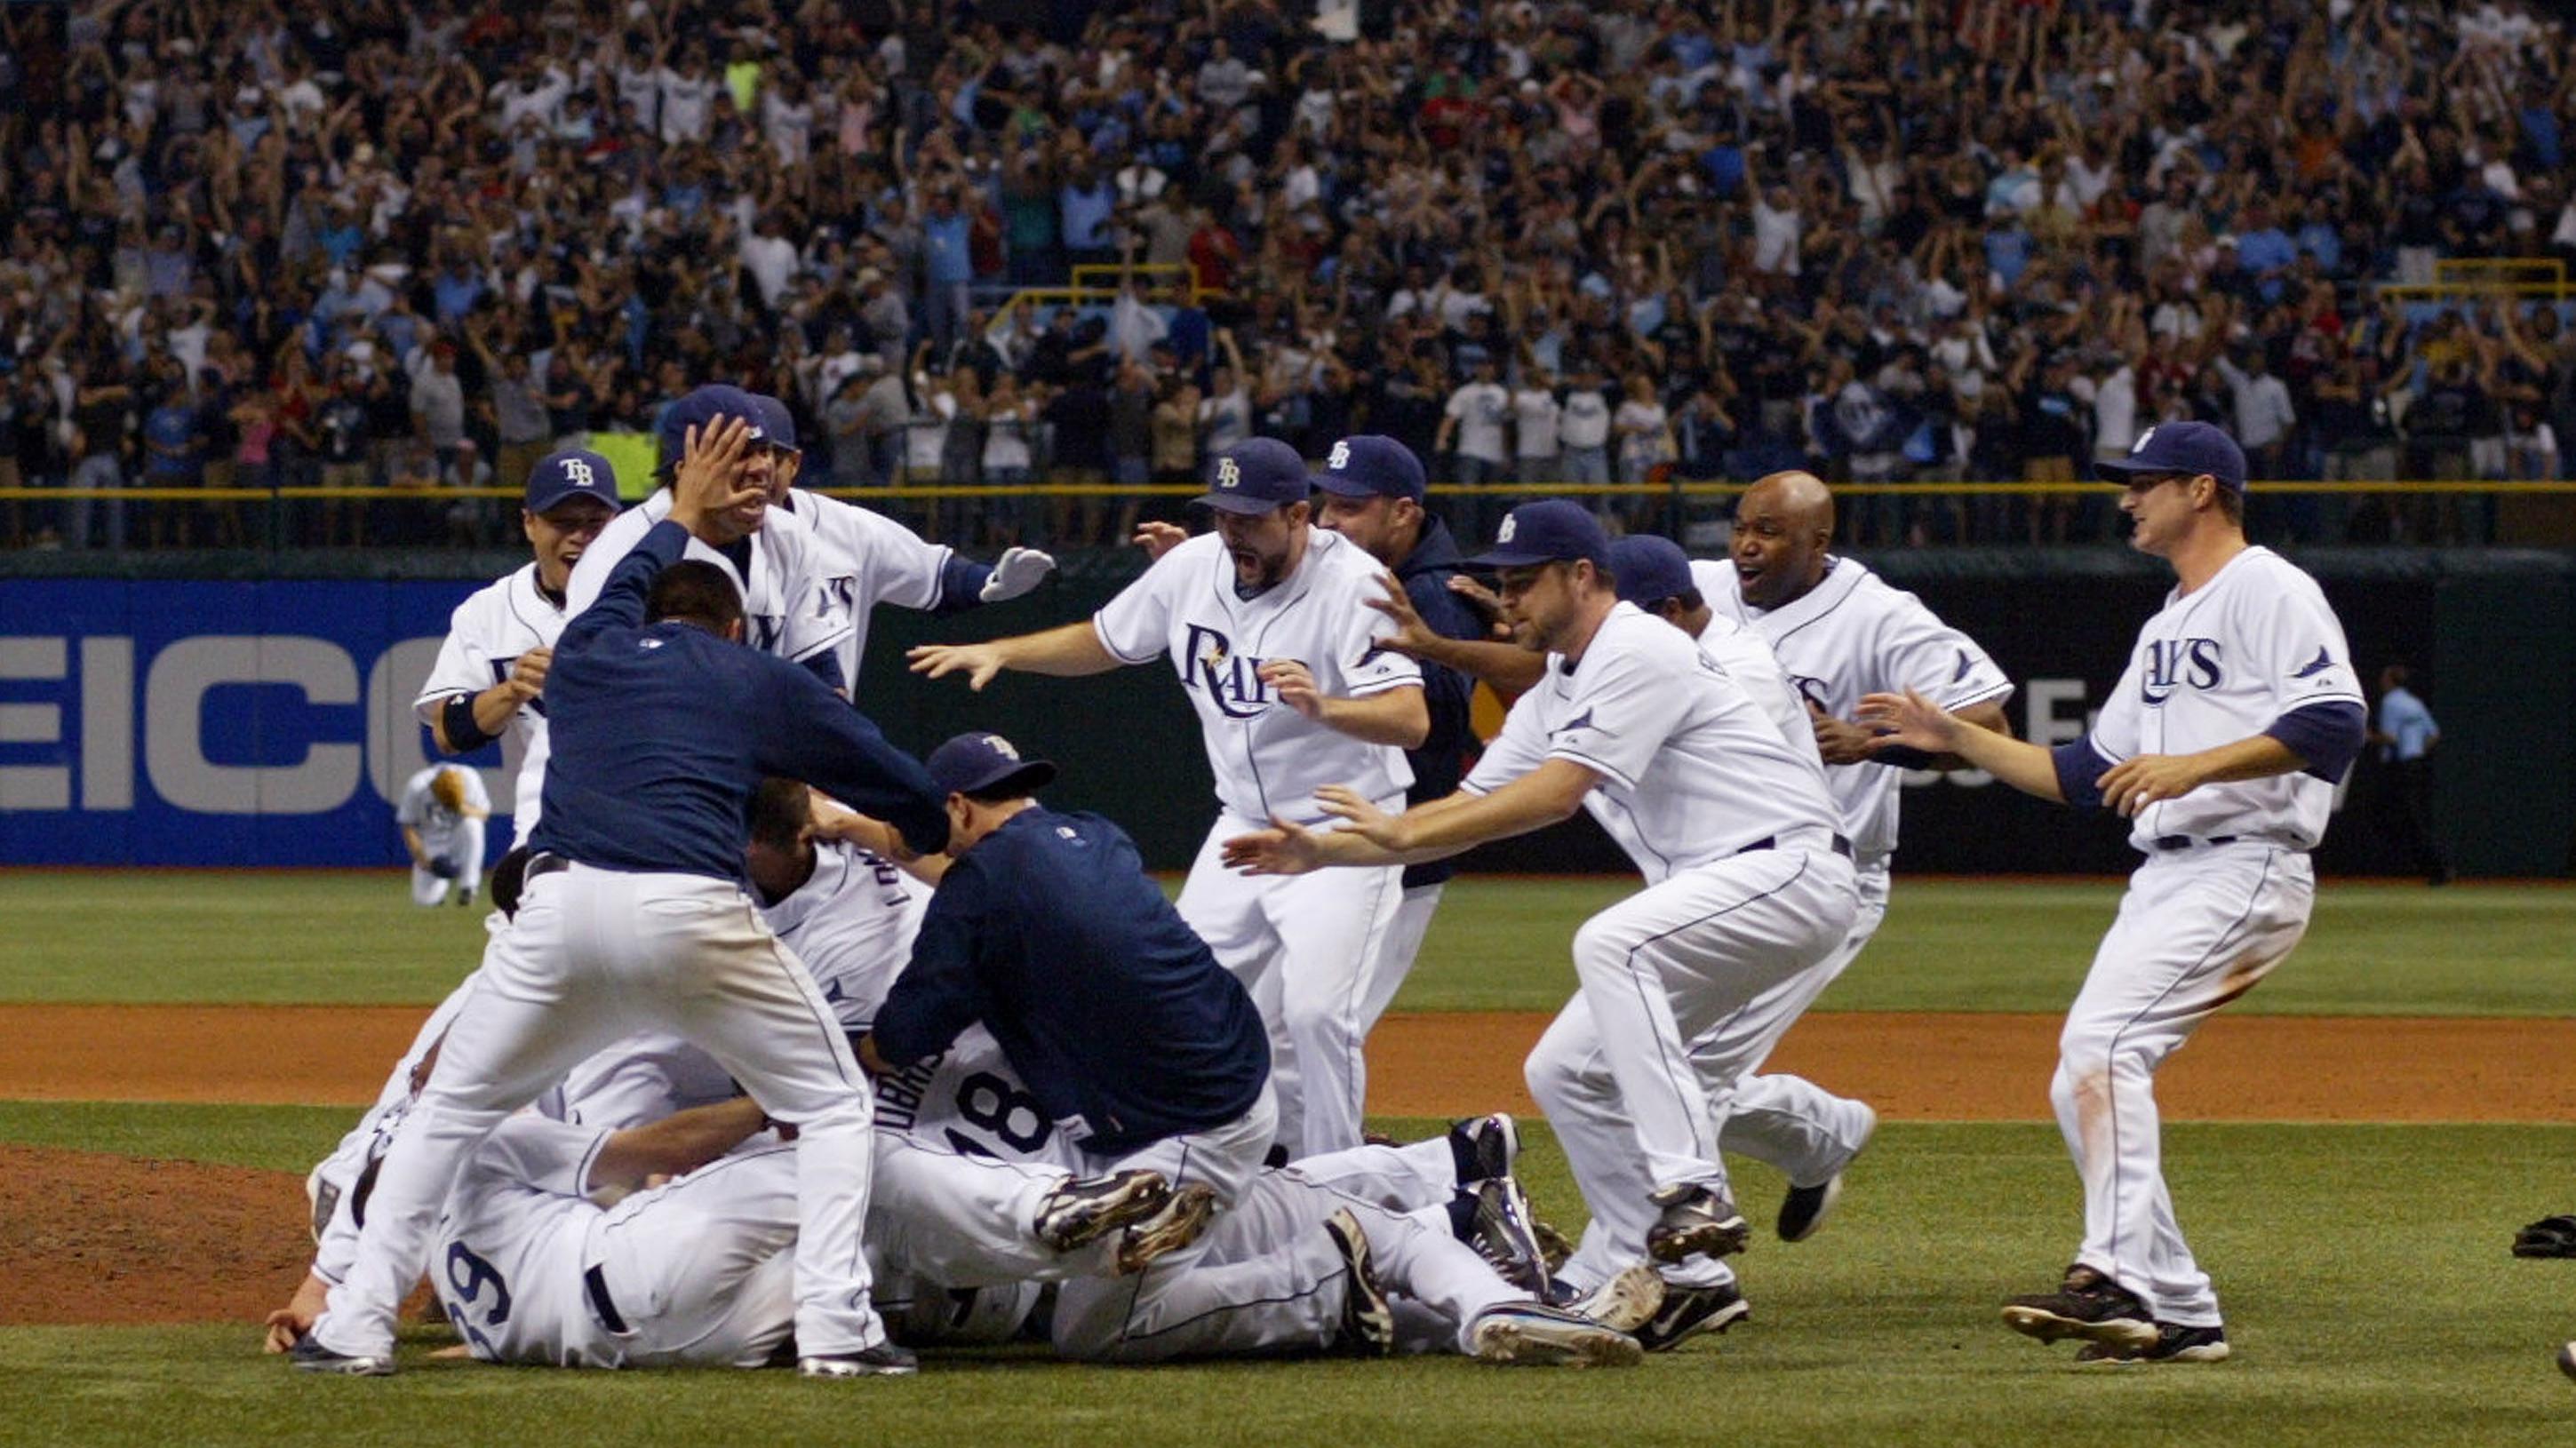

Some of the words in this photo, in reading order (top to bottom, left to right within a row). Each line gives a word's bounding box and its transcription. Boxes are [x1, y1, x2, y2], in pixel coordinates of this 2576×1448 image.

[558, 458, 594, 487] TB
[1217, 457, 1240, 488] TB
[2141, 638, 2222, 705] AYS
[945, 1071, 1053, 1154] 18
